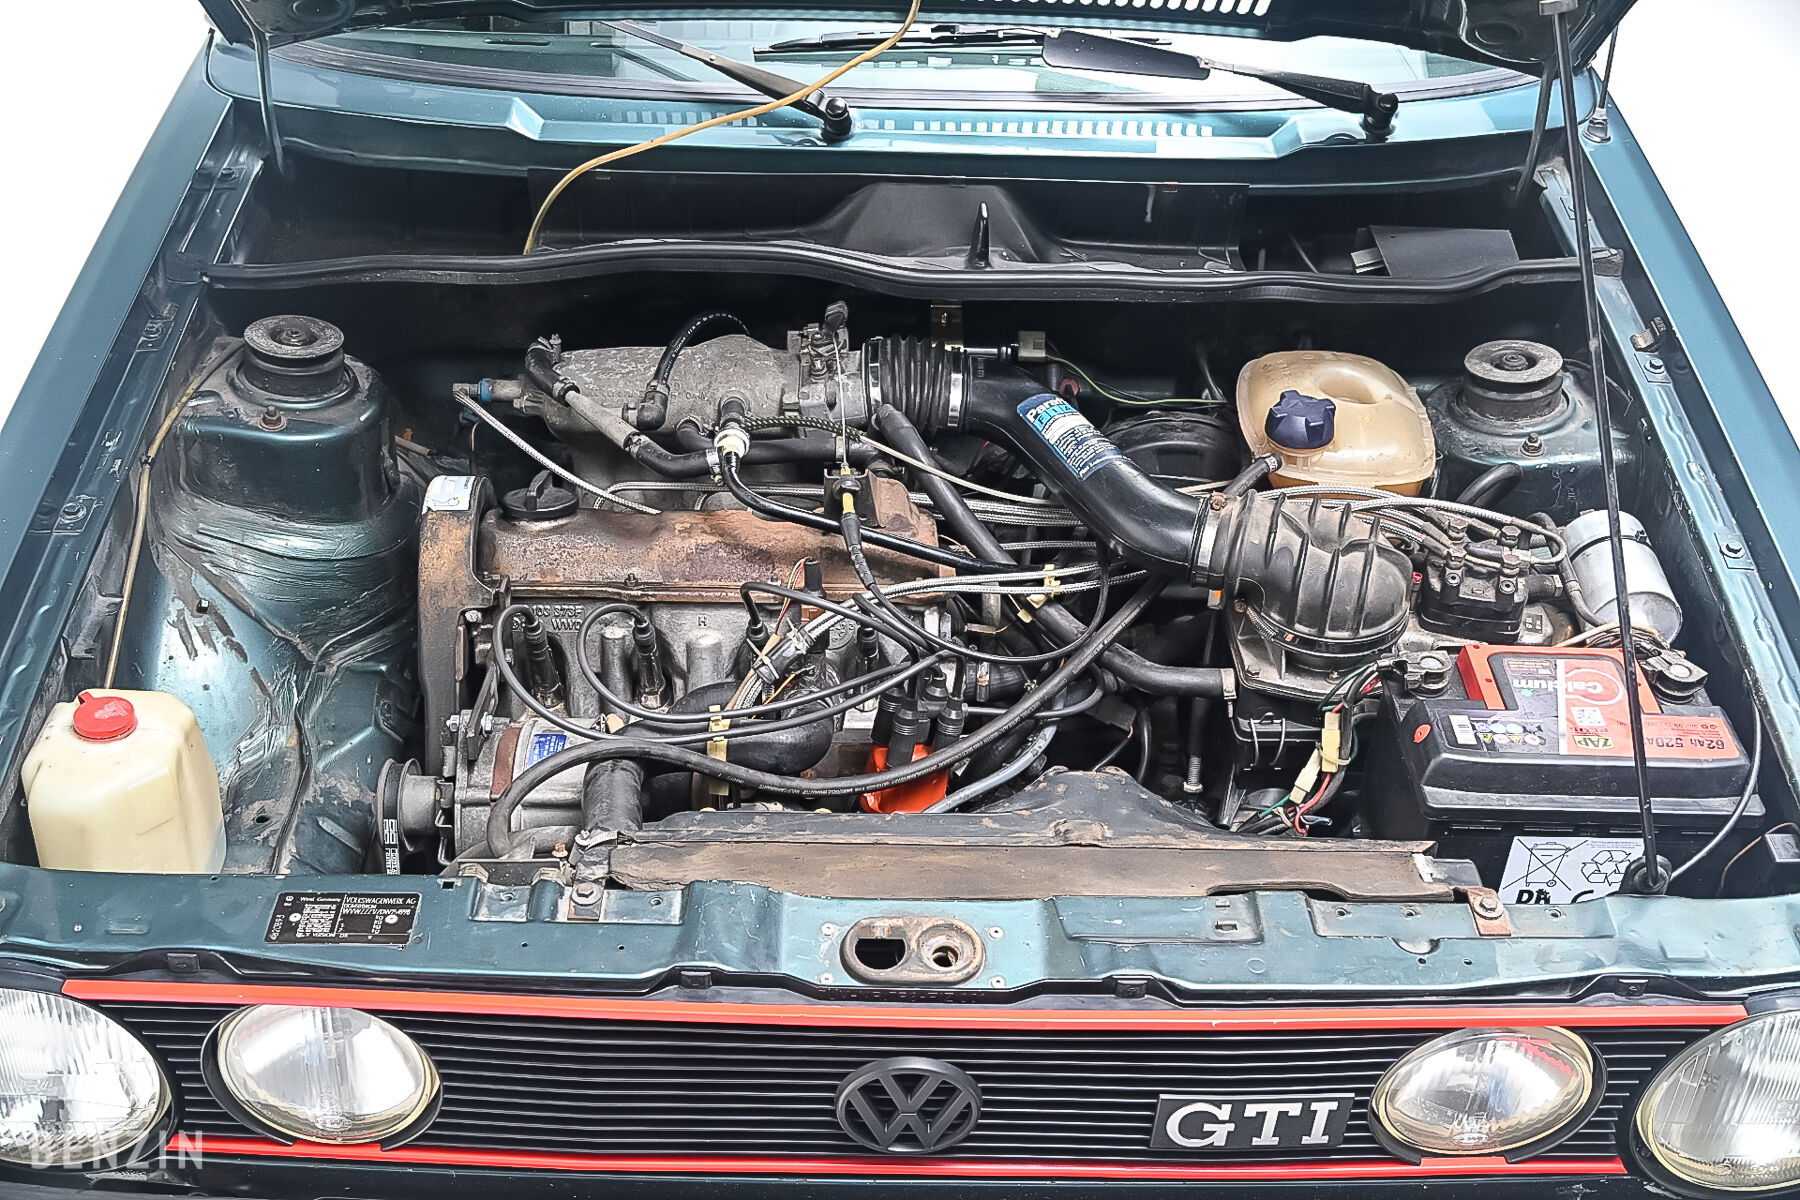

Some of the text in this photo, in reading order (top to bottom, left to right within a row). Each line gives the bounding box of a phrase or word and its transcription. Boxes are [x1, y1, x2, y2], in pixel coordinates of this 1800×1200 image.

[1512, 678, 1603, 694] Calium
[1577, 737, 1613, 748] ZAP
[1690, 738, 1725, 750] 62Ah
[1165, 1101, 1339, 1147] GTI
